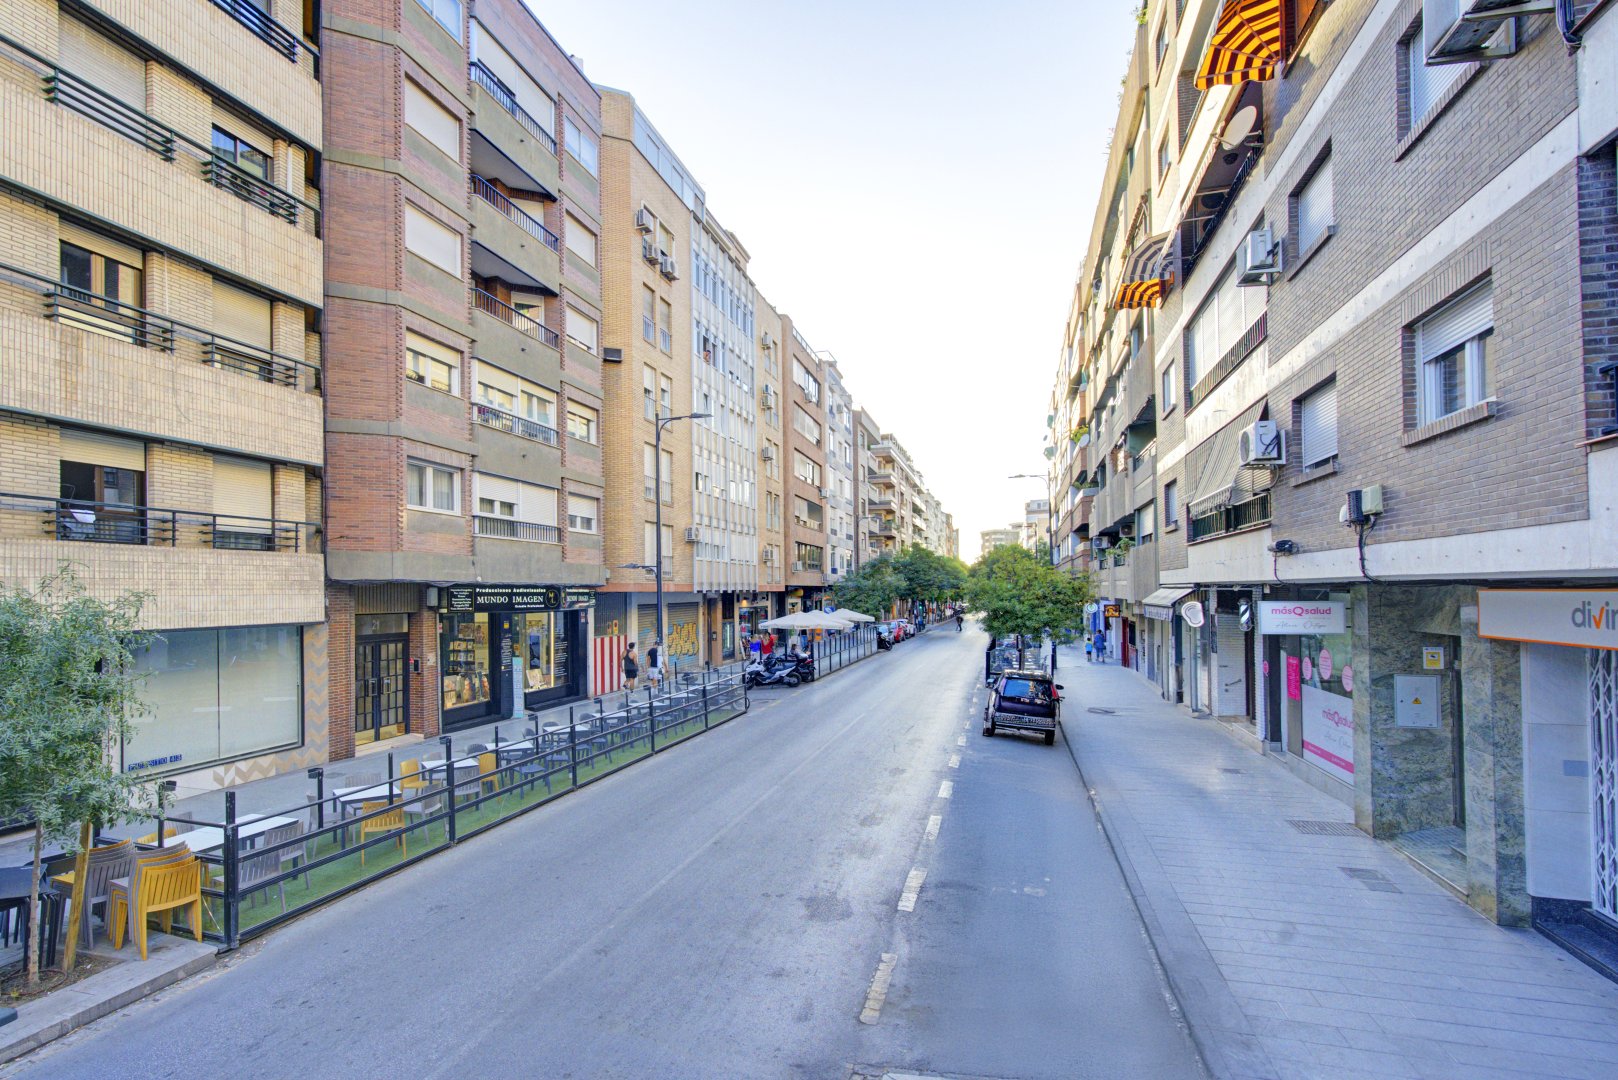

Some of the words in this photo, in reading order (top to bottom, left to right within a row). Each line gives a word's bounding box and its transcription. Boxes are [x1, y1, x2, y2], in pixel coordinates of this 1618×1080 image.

[476, 595, 509, 604] MUNDO
[512, 595, 544, 603] IMAGEN
[1271, 606, 1332, 617] másQsalud
[372, 619, 380, 630] 21
